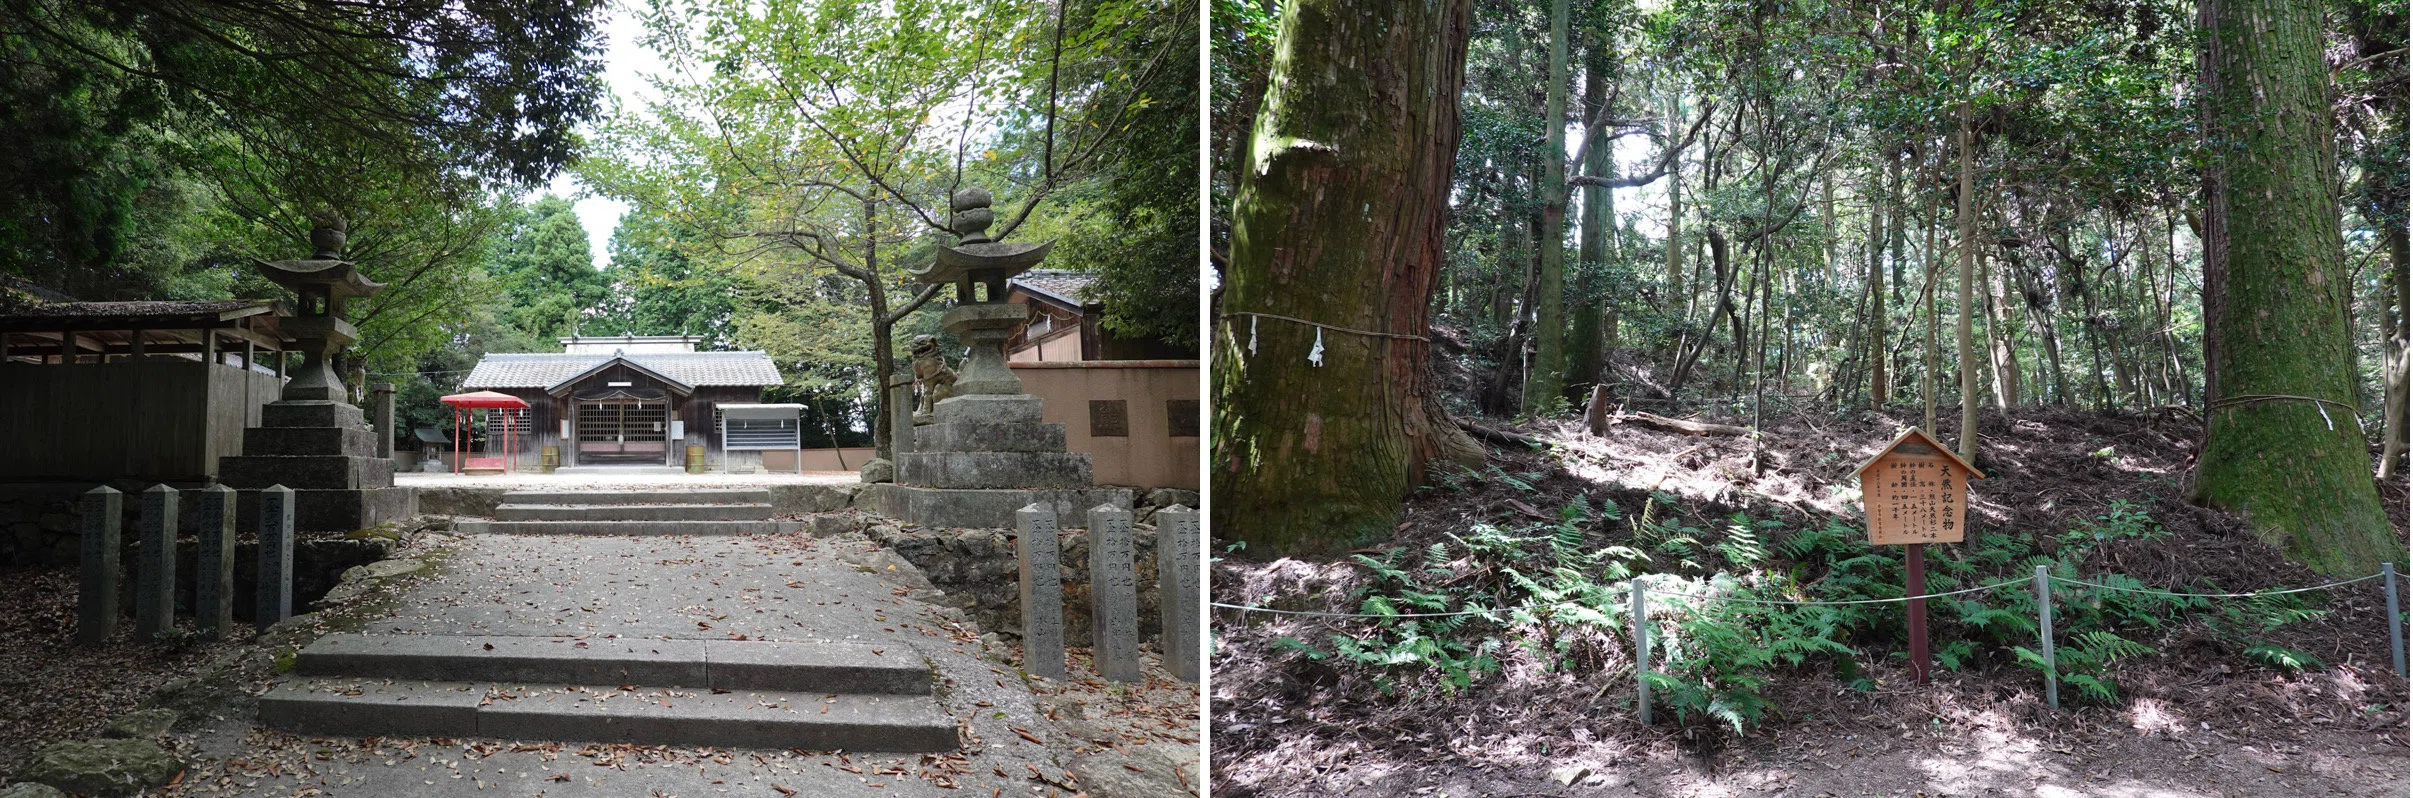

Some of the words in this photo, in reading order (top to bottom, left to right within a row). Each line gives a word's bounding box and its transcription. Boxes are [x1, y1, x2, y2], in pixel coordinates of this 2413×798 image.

[1940, 465, 1954, 531] 天然記念物
